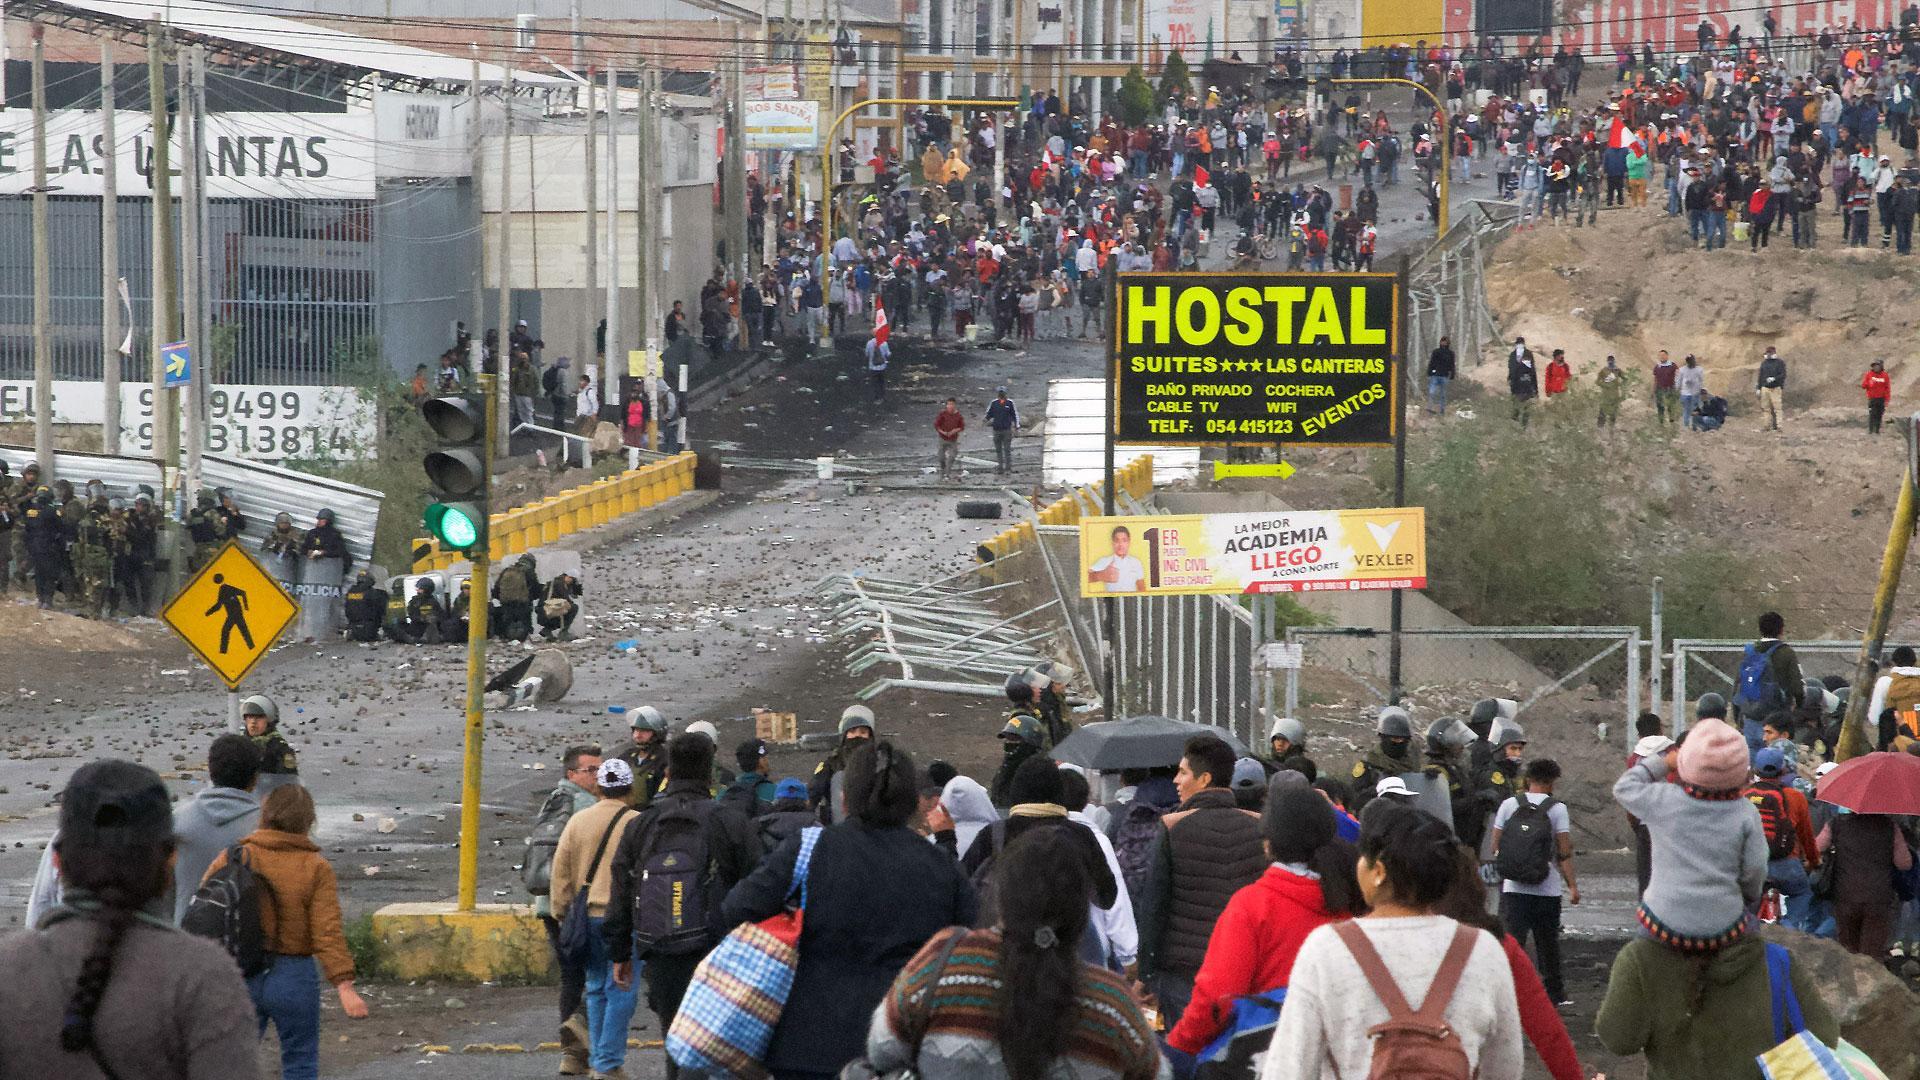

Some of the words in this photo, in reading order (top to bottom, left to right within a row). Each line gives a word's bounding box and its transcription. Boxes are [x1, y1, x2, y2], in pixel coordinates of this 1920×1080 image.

[775, 103, 812, 123] SAUNA
[135, 136, 329, 178] LNTAS
[1128, 286, 1386, 346] HOSTAL
[1131, 357, 1217, 373] SUITES
[1267, 358, 1297, 374] LAS
[1301, 358, 1385, 374] CANTERAS
[1147, 382, 1187, 396] BAÑO
[1192, 385, 1252, 396] PRIVADO
[1265, 385, 1335, 397] COCHERA
[1147, 401, 1192, 413] CABLE
[1200, 402, 1219, 413] TV
[1267, 402, 1297, 413] WIFI
[1301, 384, 1385, 436] EVENTOS
[1148, 420, 1193, 433] TELF:
[1206, 420, 1236, 434] 054
[1239, 420, 1293, 434] 415123
[1235, 525, 1249, 534] LA
[1252, 519, 1290, 532] MEJOR
[1224, 526, 1328, 555] ACADEMIA
[1144, 528, 1159, 587] 1
[1163, 529, 1179, 545] ER
[1185, 559, 1210, 571] CIVIL
[1251, 544, 1322, 571] LLEGÓ
[1354, 554, 1414, 566] VEXLER
[1280, 566, 1307, 576] CONO
[1309, 562, 1339, 573] NORTE
[296, 585, 340, 598] POLICIA
